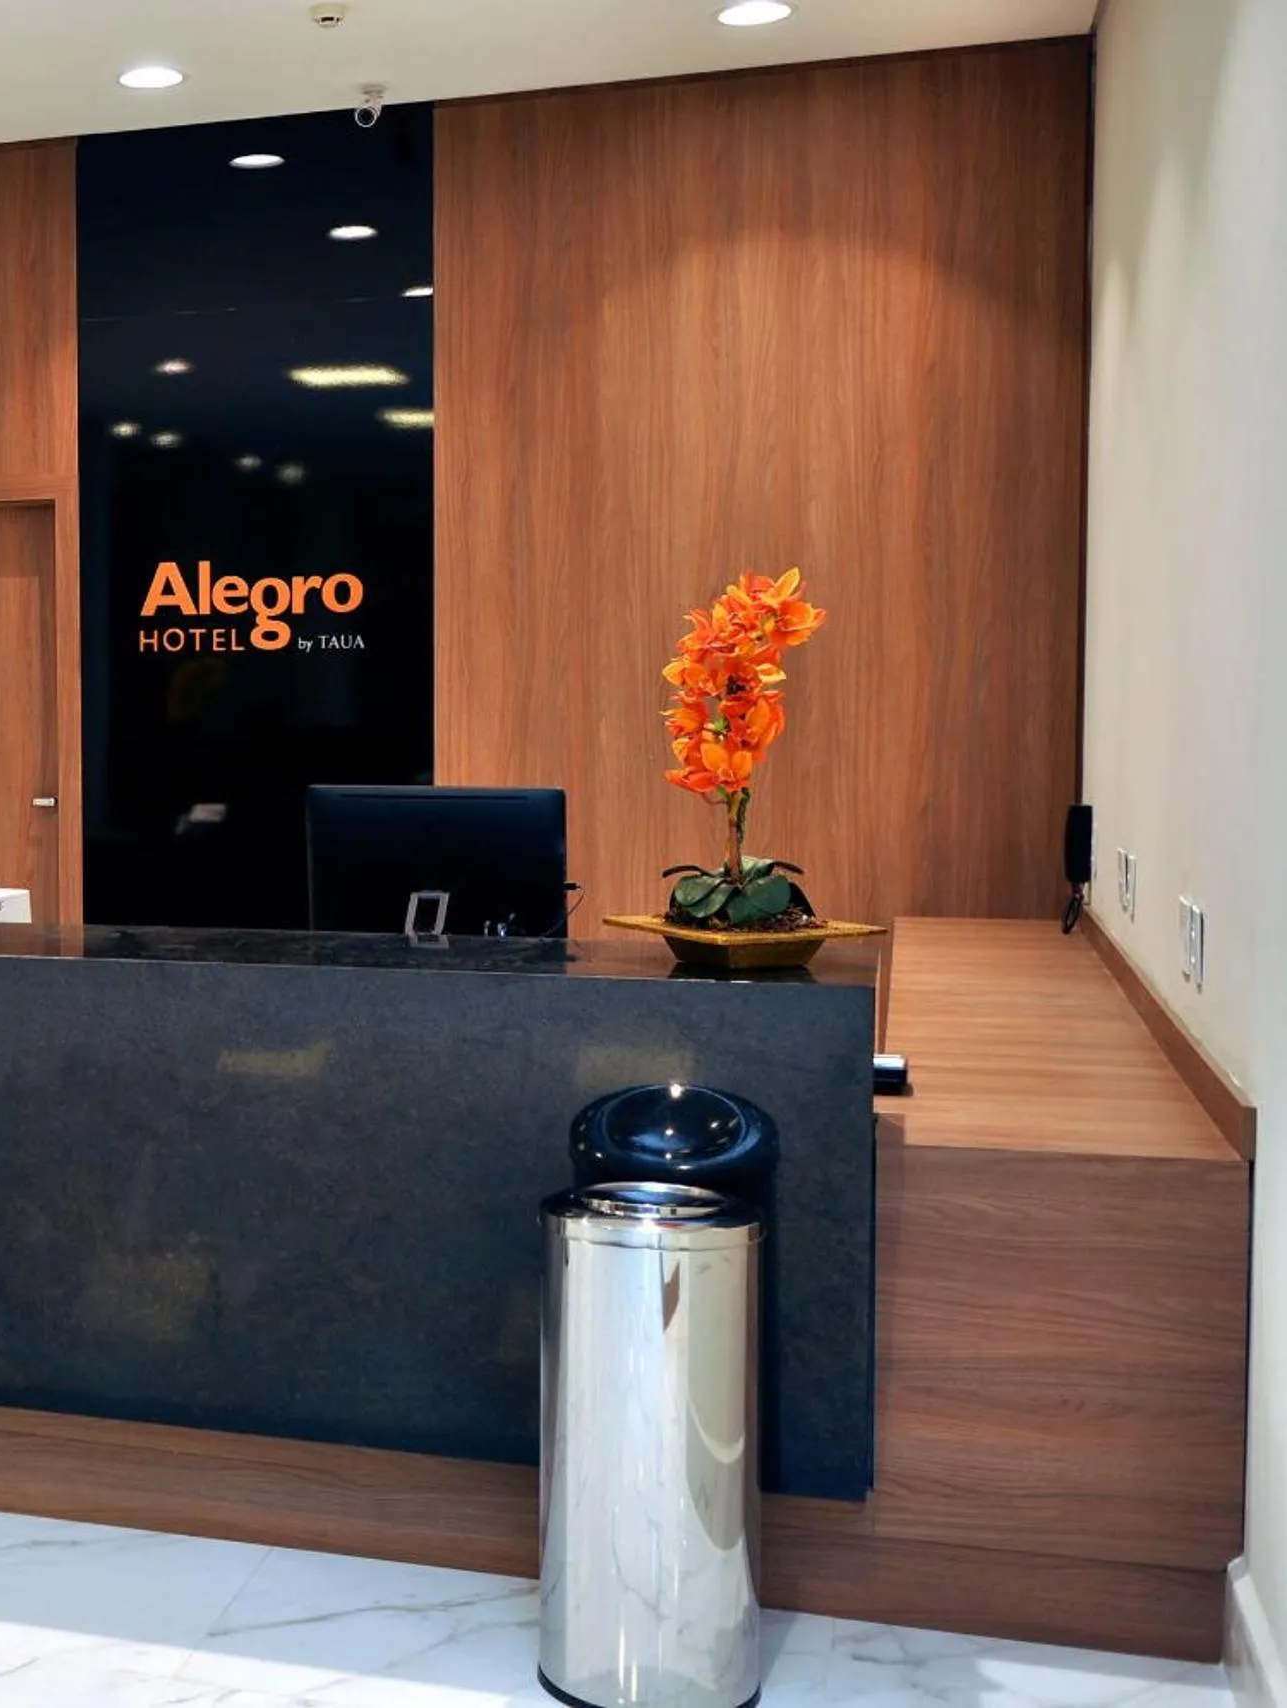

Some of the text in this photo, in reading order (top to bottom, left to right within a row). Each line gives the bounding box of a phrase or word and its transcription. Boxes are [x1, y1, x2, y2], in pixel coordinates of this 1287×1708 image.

[140, 560, 364, 650] Alegro
[139, 628, 245, 652] HOTEL
[298, 635, 364, 652] by TAUA
